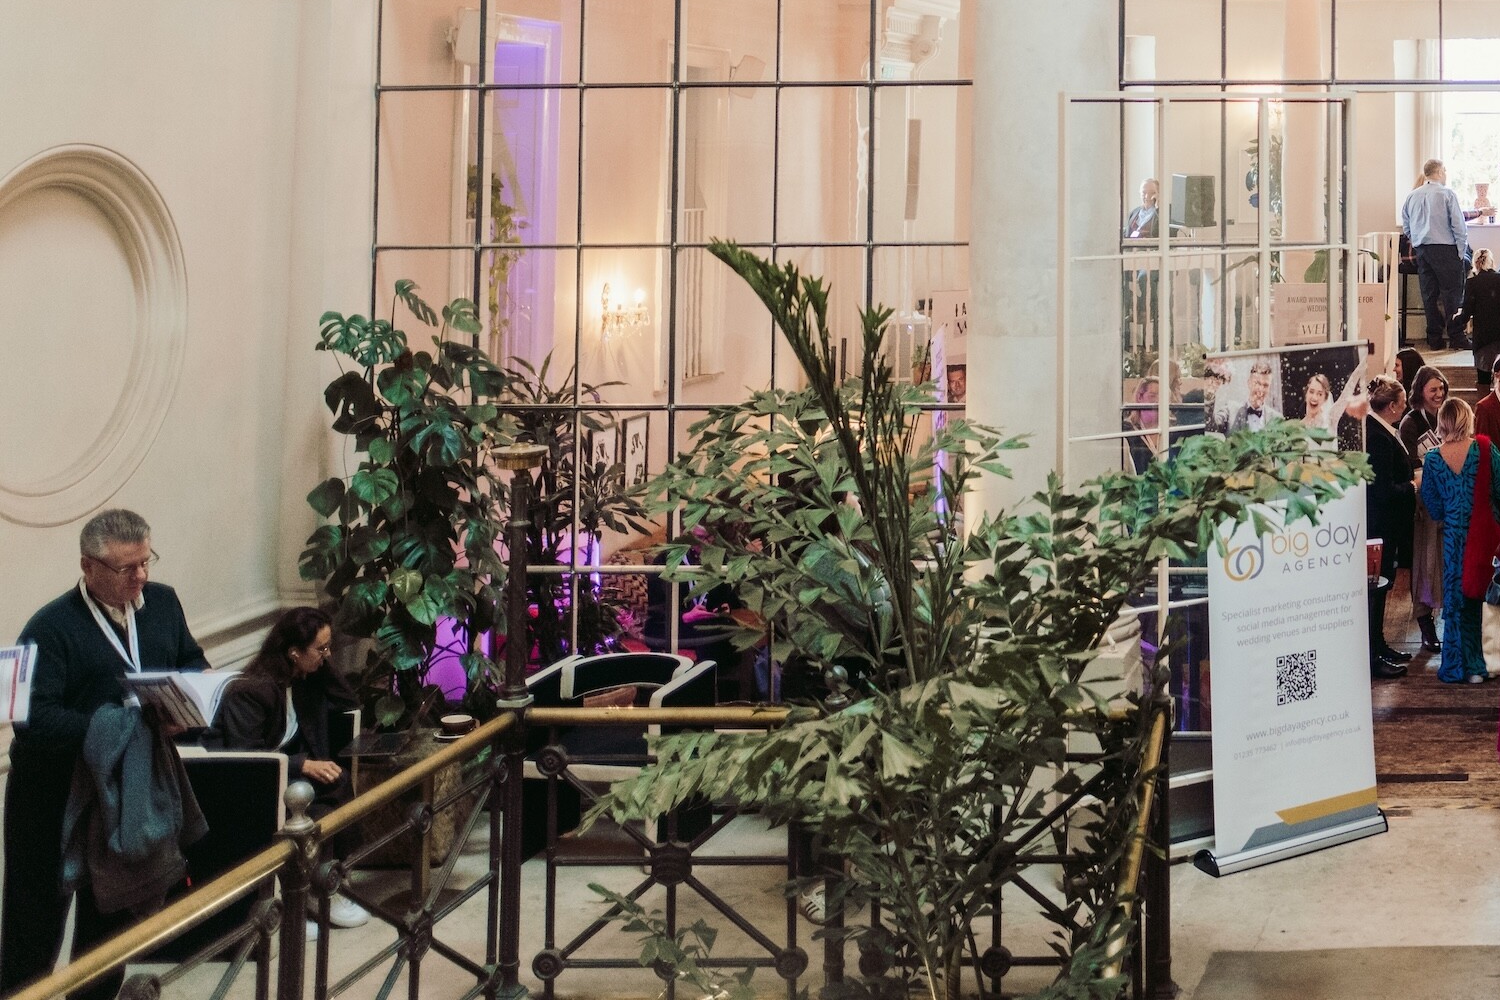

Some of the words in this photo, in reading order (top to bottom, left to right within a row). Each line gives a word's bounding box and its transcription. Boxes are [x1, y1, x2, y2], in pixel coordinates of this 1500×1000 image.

[1307, 305, 1328, 313] WEDDIN
[1271, 529, 1309, 557] big
[1315, 522, 1360, 549] day
[1282, 552, 1354, 574] AGENCY
[1221, 608, 1261, 622] Specialist
[1262, 599, 1301, 614] marketing
[1302, 591, 1350, 606] consultancy
[1350, 588, 1363, 598] and
[1236, 621, 1260, 633] social
[1261, 617, 1285, 629] media
[1286, 606, 1339, 623] management
[1340, 604, 1352, 613] for
[1236, 633, 1271, 647] wedding
[1272, 628, 1300, 640] venues
[1301, 623, 1317, 634] and
[1318, 617, 1354, 632] suppliers
[1246, 710, 1350, 741] www.bigdayagency.co.uk
